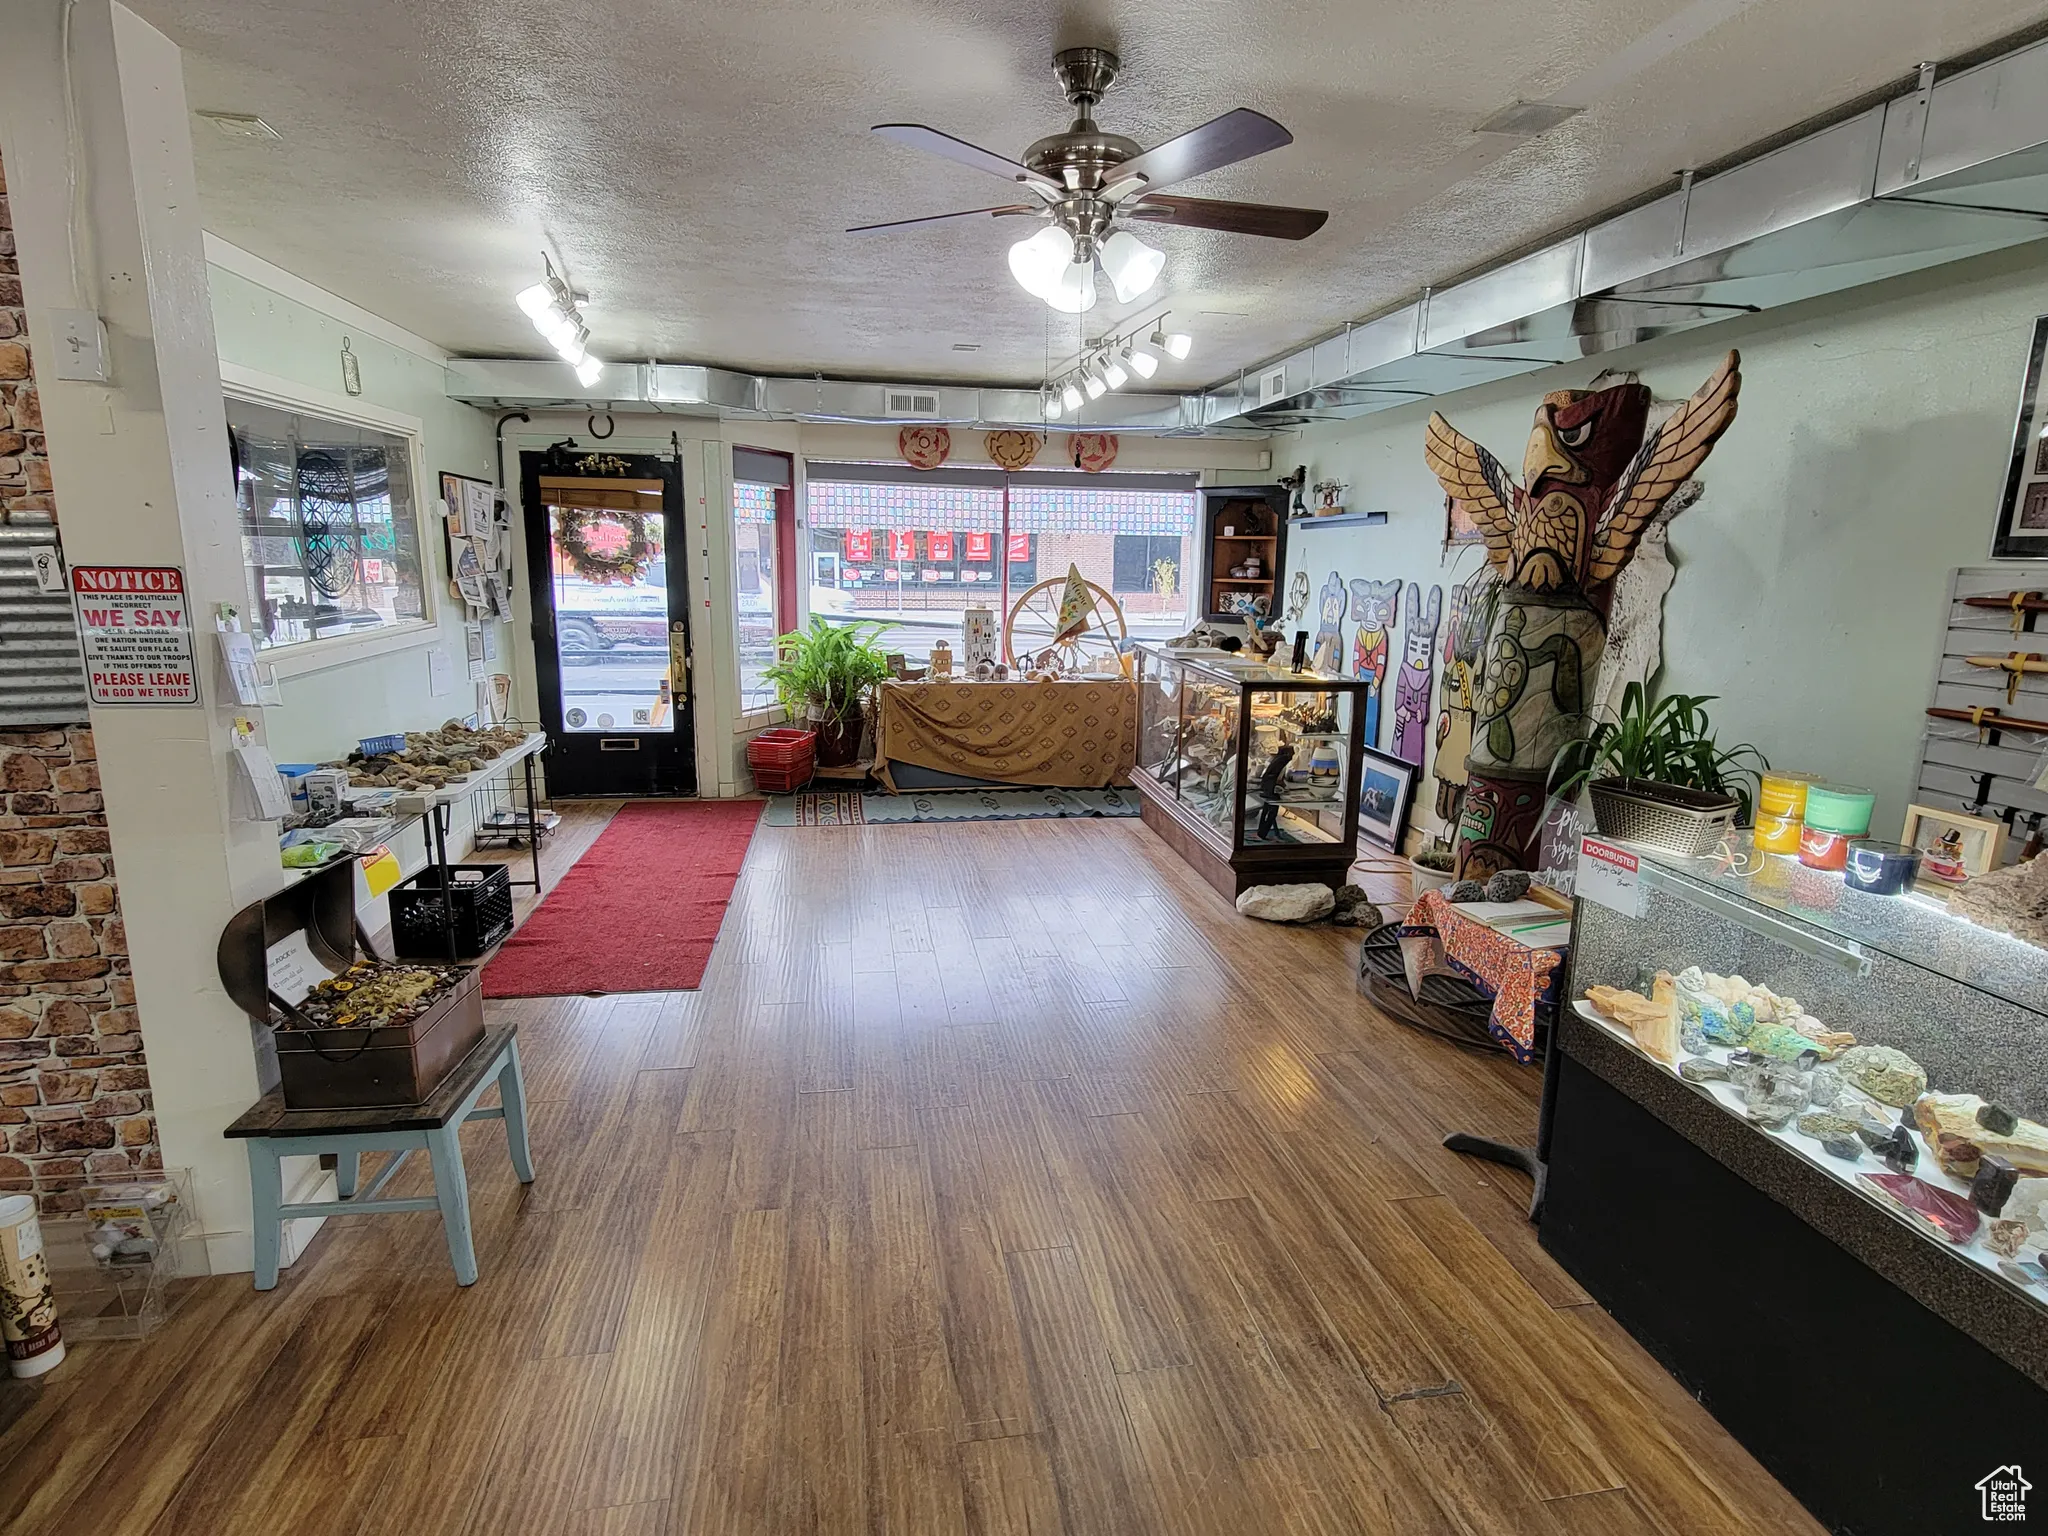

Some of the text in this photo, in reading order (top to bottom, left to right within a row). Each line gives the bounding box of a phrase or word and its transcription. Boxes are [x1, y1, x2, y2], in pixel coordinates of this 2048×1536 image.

[79, 570, 179, 590] NOTICE
[83, 610, 181, 627] WE SAY
[93, 672, 191, 686] PLEASE LEAVE
[98, 689, 189, 697] IN GOD WE TRUST
[1543, 837, 1579, 865] sign
[1586, 843, 1637, 869] DOORBUSTER
[275, 950, 291, 964] ROCK
